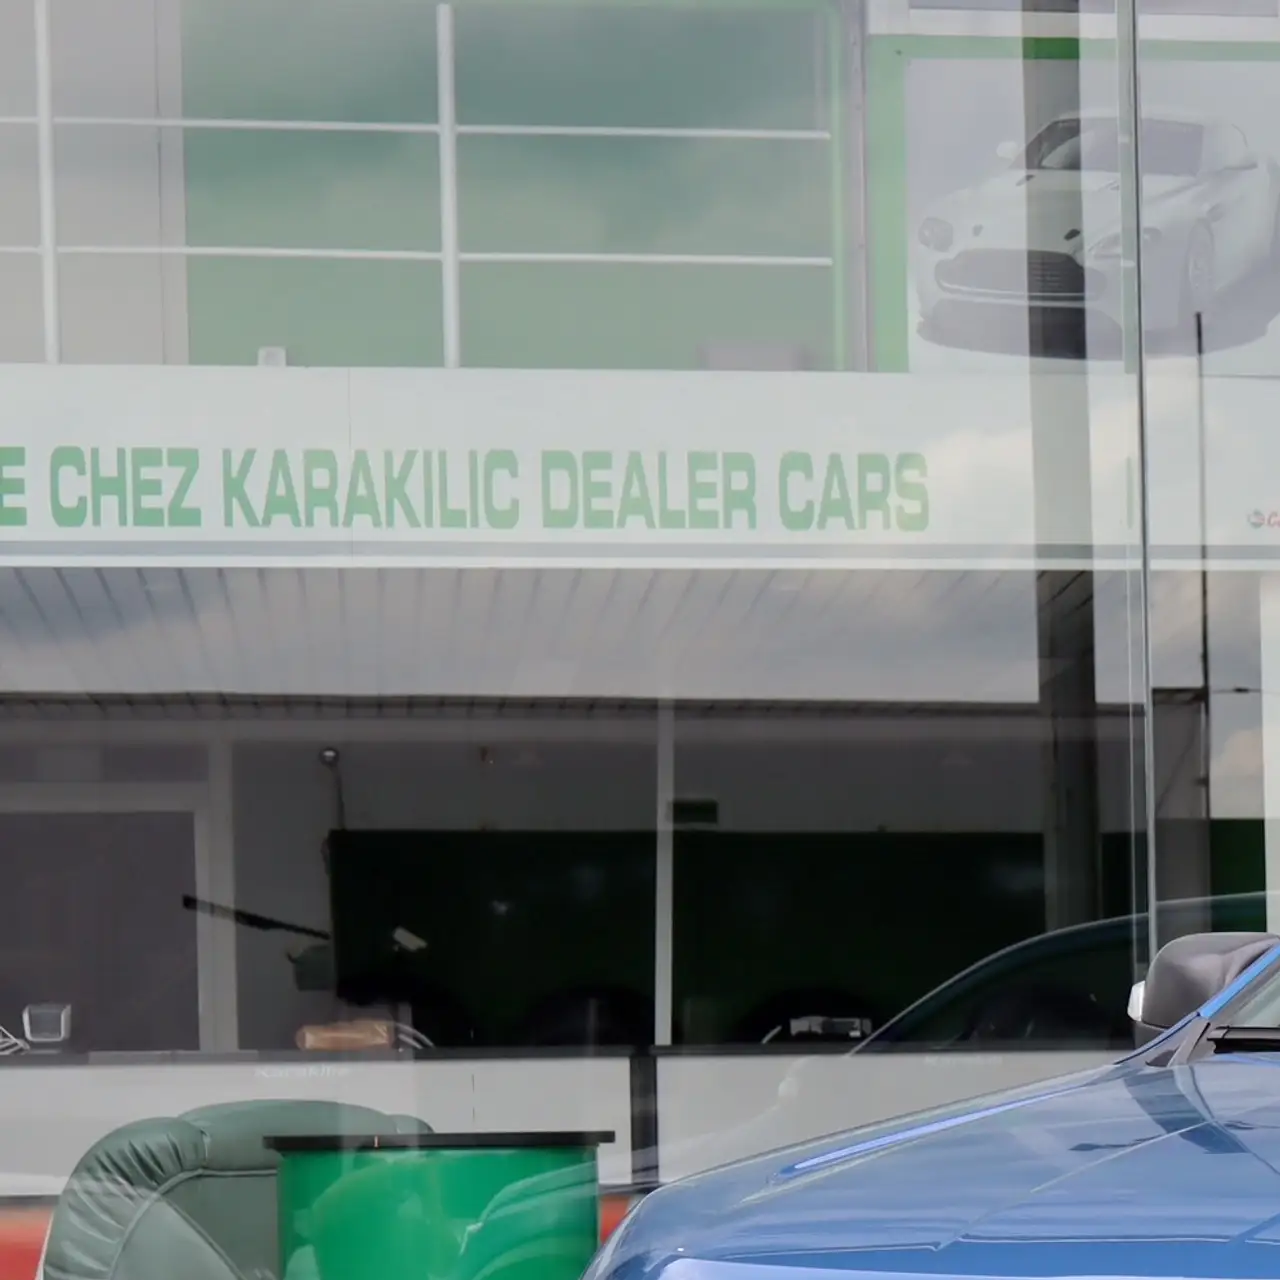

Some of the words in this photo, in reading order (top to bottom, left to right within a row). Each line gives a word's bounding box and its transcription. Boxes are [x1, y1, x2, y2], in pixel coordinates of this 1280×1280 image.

[49, 446, 201, 527] CHEZ
[222, 448, 519, 529] KARAKILIC
[541, 450, 757, 530] DEALER
[778, 451, 930, 531] CARS
